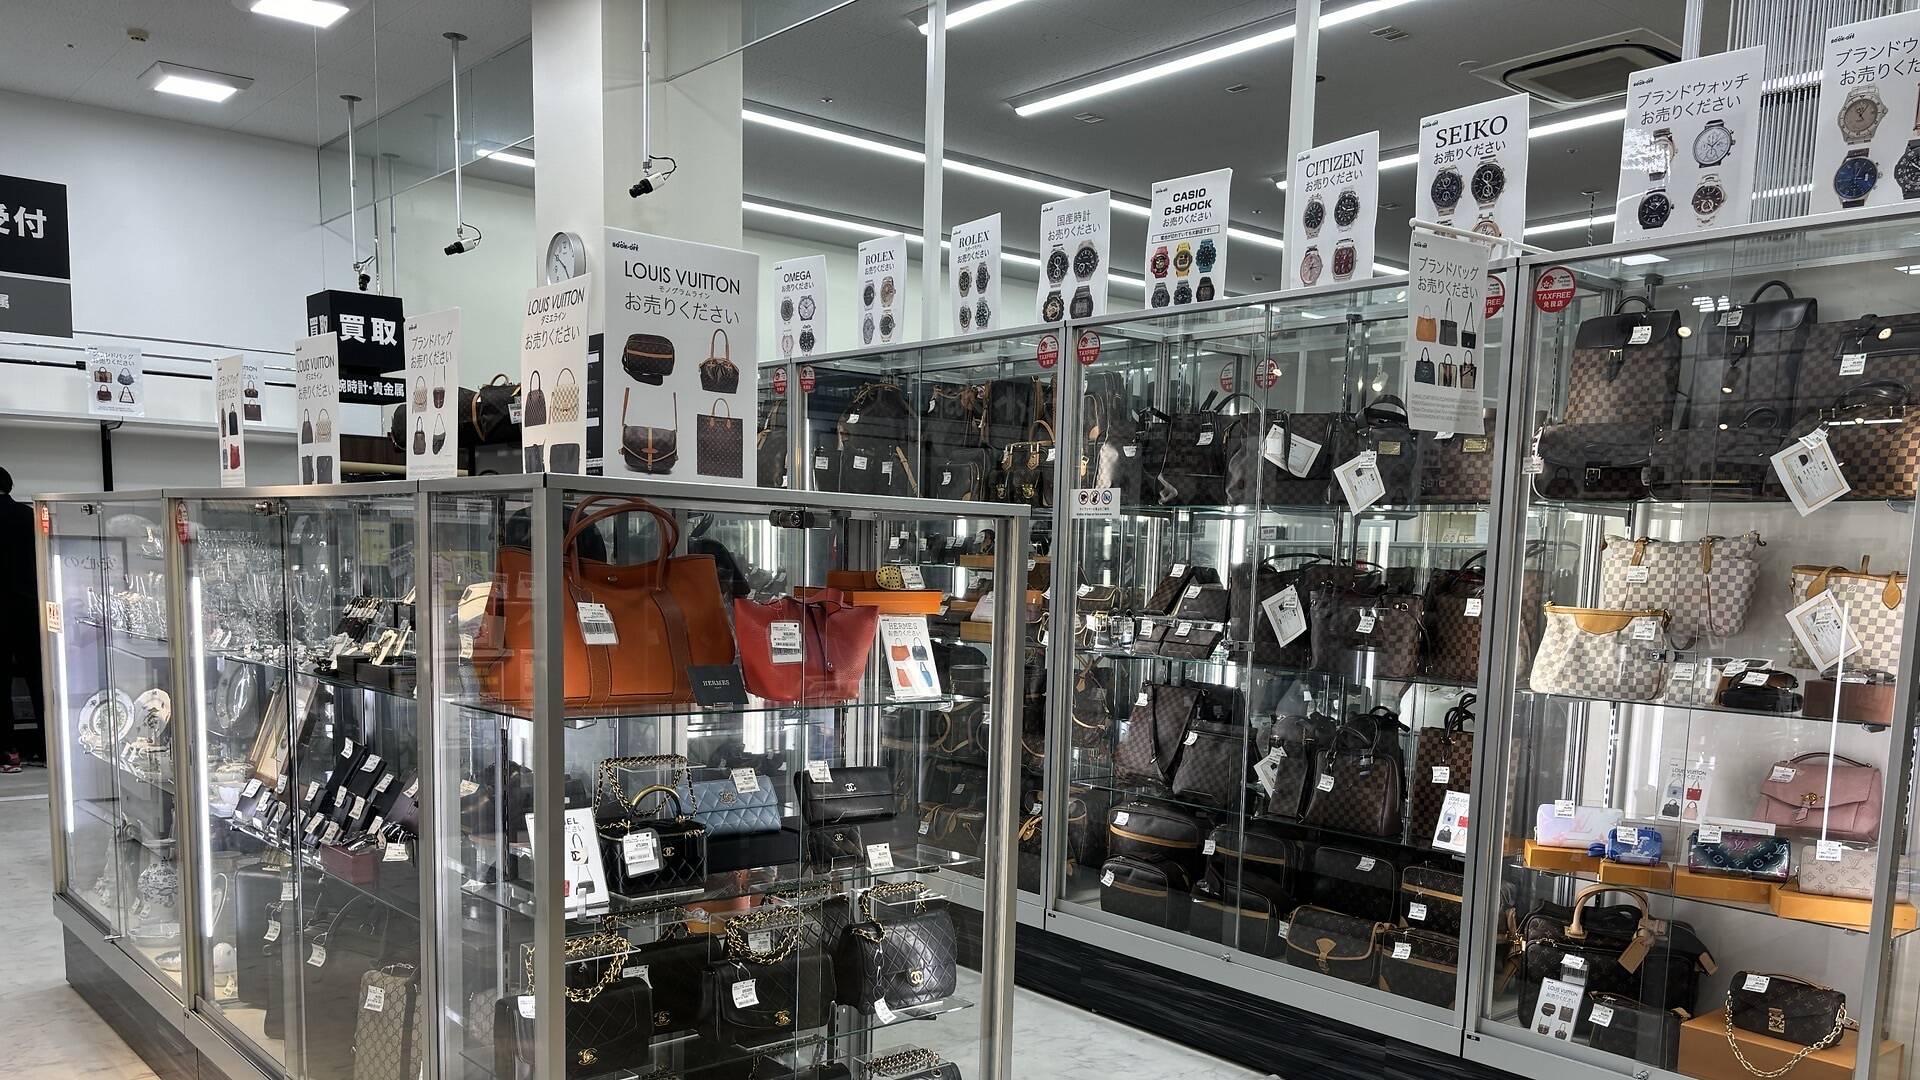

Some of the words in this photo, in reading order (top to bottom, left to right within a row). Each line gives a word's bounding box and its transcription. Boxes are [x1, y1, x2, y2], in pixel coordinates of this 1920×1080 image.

[1638, 72, 1750, 109] ブランドウォッチ
[1641, 95, 1741, 126] お売りください
[1436, 115, 1508, 149] SEIKO
[1433, 139, 1506, 166] お売りください
[1305, 149, 1364, 178] CITIZEN
[1305, 169, 1363, 193] お売りください
[1173, 188, 1206, 202] CASIO
[1164, 198, 1212, 216] G-SHOCK
[1056, 209, 1091, 227] 国産時計
[1162, 212, 1212, 228] お売りください
[958, 230, 990, 248] ROLEX
[1047, 223, 1101, 241] お売りください
[865, 249, 895, 266] ROLEX
[957, 250, 990, 264] お売りください
[625, 260, 671, 283] LOUIS
[676, 269, 740, 295] VUITTON
[783, 270, 812, 283] OMEGA
[864, 263, 895, 276] お売りください
[1418, 257, 1479, 281] ブランドバッグ
[659, 285, 712, 300] モノグラムライン
[781, 282, 815, 293] お売りください
[1417, 276, 1478, 299] お売りください
[1537, 291, 1571, 300] TAXFREE
[527, 296, 550, 316] LOUIS
[552, 287, 585, 309] VUITTON
[625, 291, 740, 325] お売りください
[541, 311, 566, 325] ダミエライン
[339, 313, 397, 346] 買取
[525, 325, 580, 351] お売りください
[411, 330, 453, 351] ブランドバッグ
[311, 354, 335, 370] VUITTON
[411, 351, 452, 369] お売りください
[298, 383, 335, 400] お売りください
[888, 622, 918, 630] HERMES
